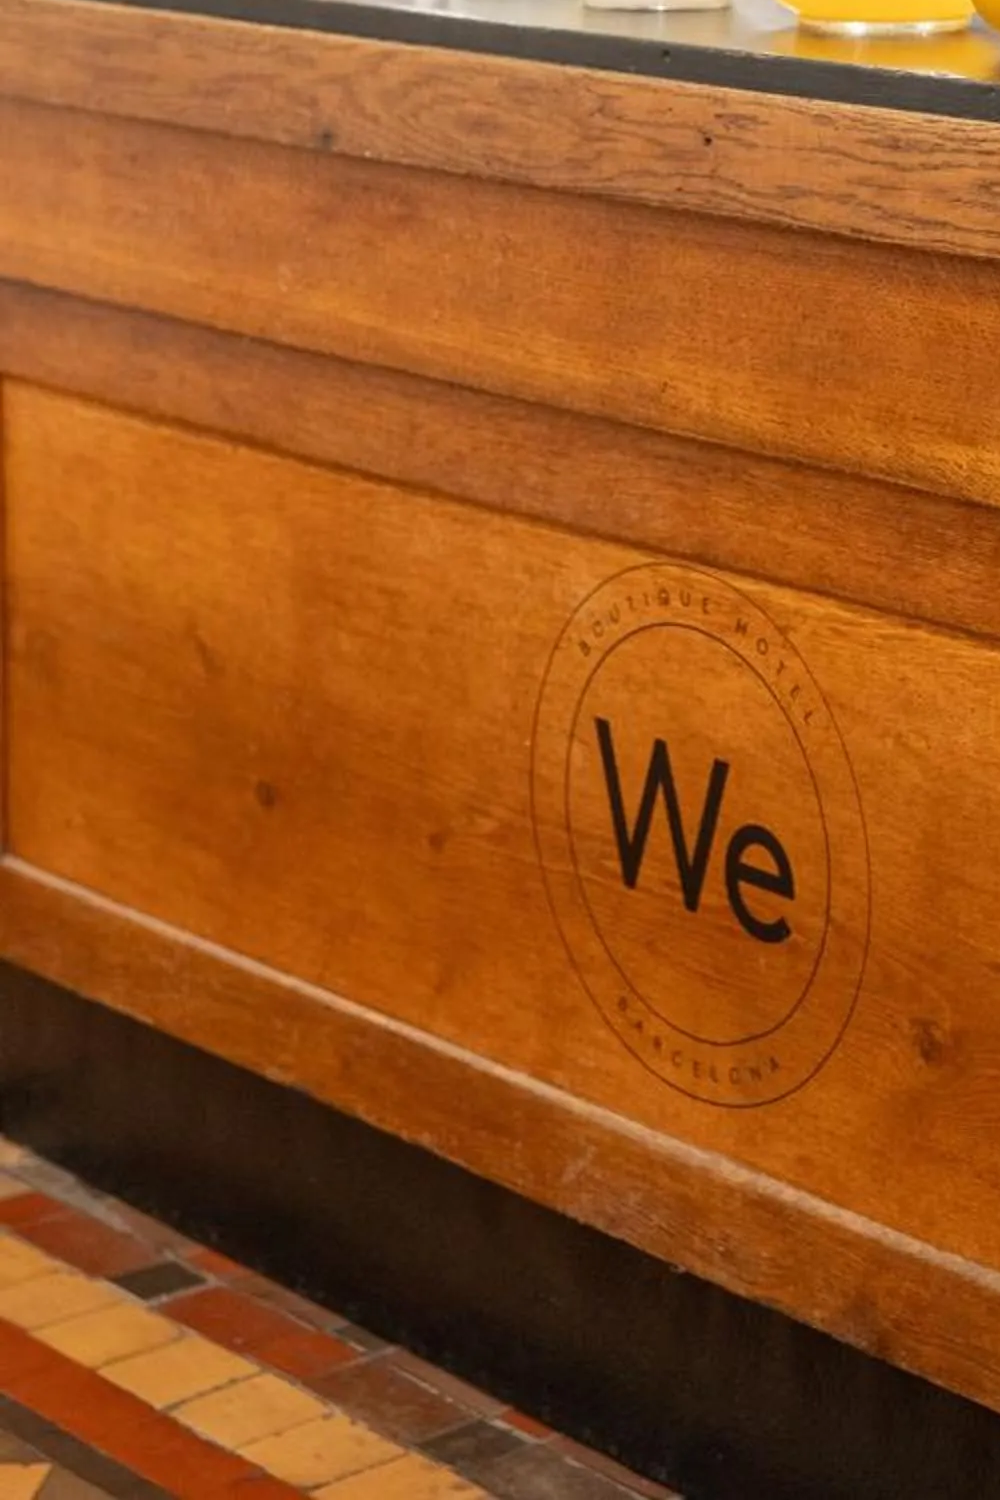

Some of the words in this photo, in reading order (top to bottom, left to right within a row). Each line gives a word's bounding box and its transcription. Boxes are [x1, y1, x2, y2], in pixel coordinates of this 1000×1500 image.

[578, 587, 710, 658] BOUTIQUE
[735, 617, 813, 725] HOTEL
[594, 715, 796, 944] We
[617, 995, 779, 1086] BARCELONA
